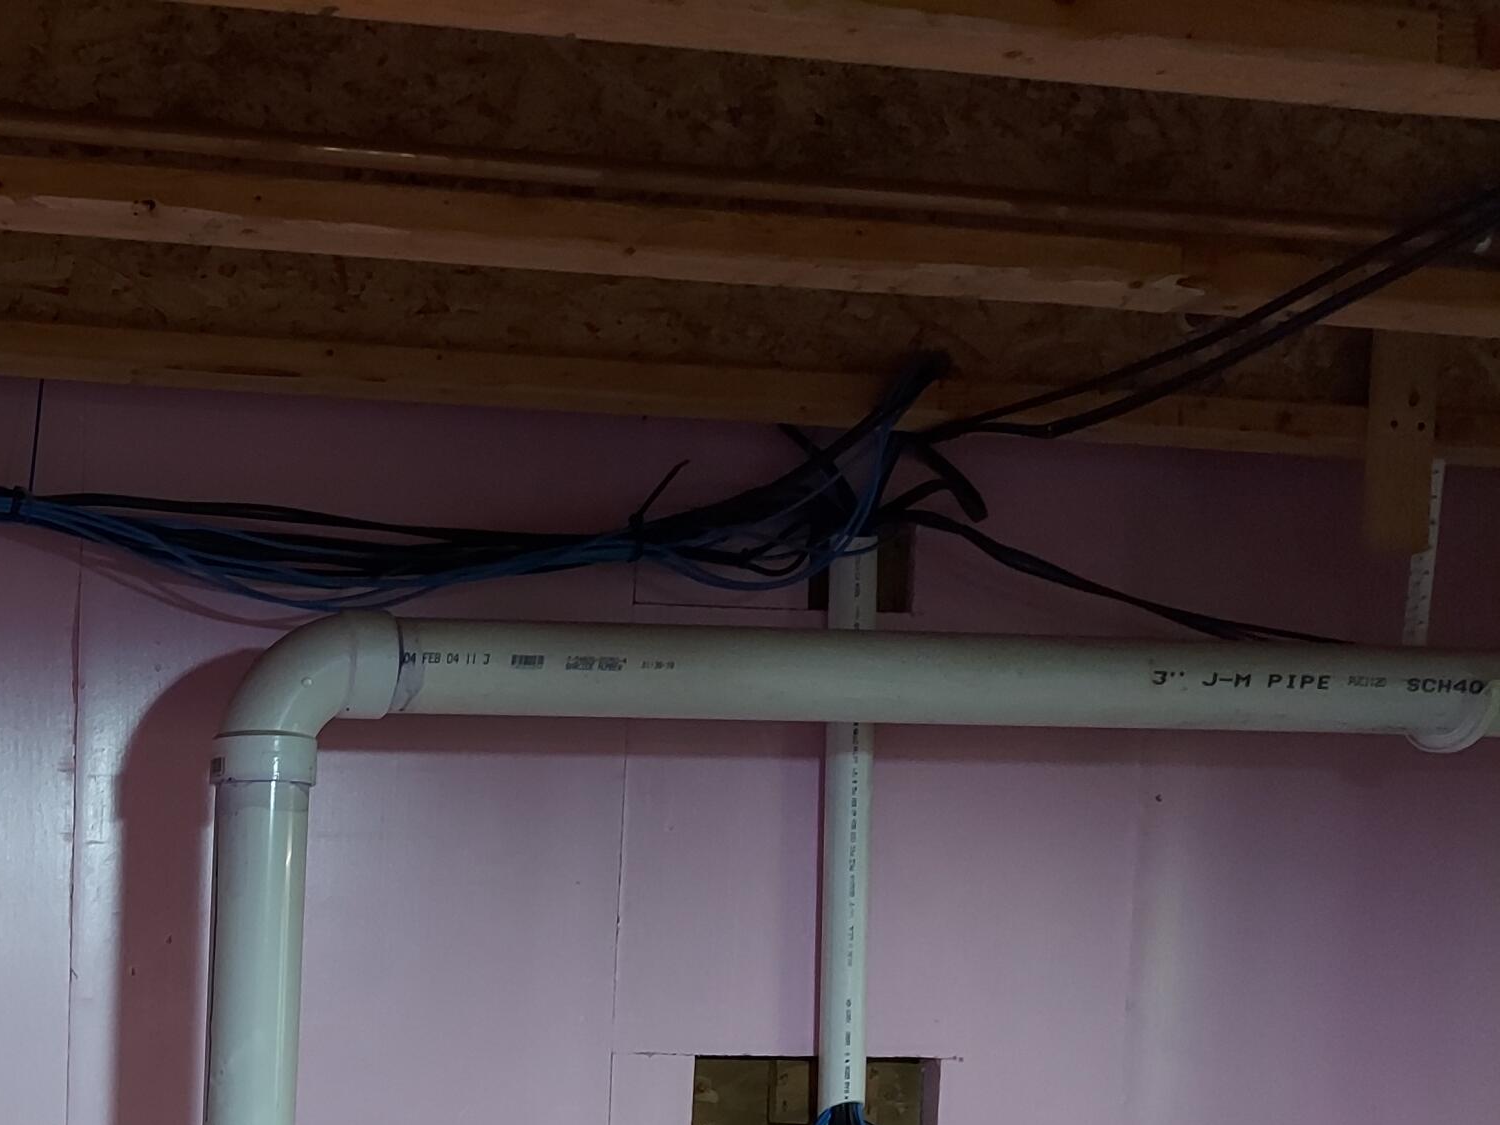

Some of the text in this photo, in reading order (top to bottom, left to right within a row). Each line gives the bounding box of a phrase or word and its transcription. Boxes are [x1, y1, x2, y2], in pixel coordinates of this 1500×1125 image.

[422, 652, 441, 664] FEB
[446, 653, 459, 664] 04
[1202, 672, 1252, 687] J-M
[1267, 674, 1332, 690] PIPE
[1406, 677, 1486, 695] SCH40
